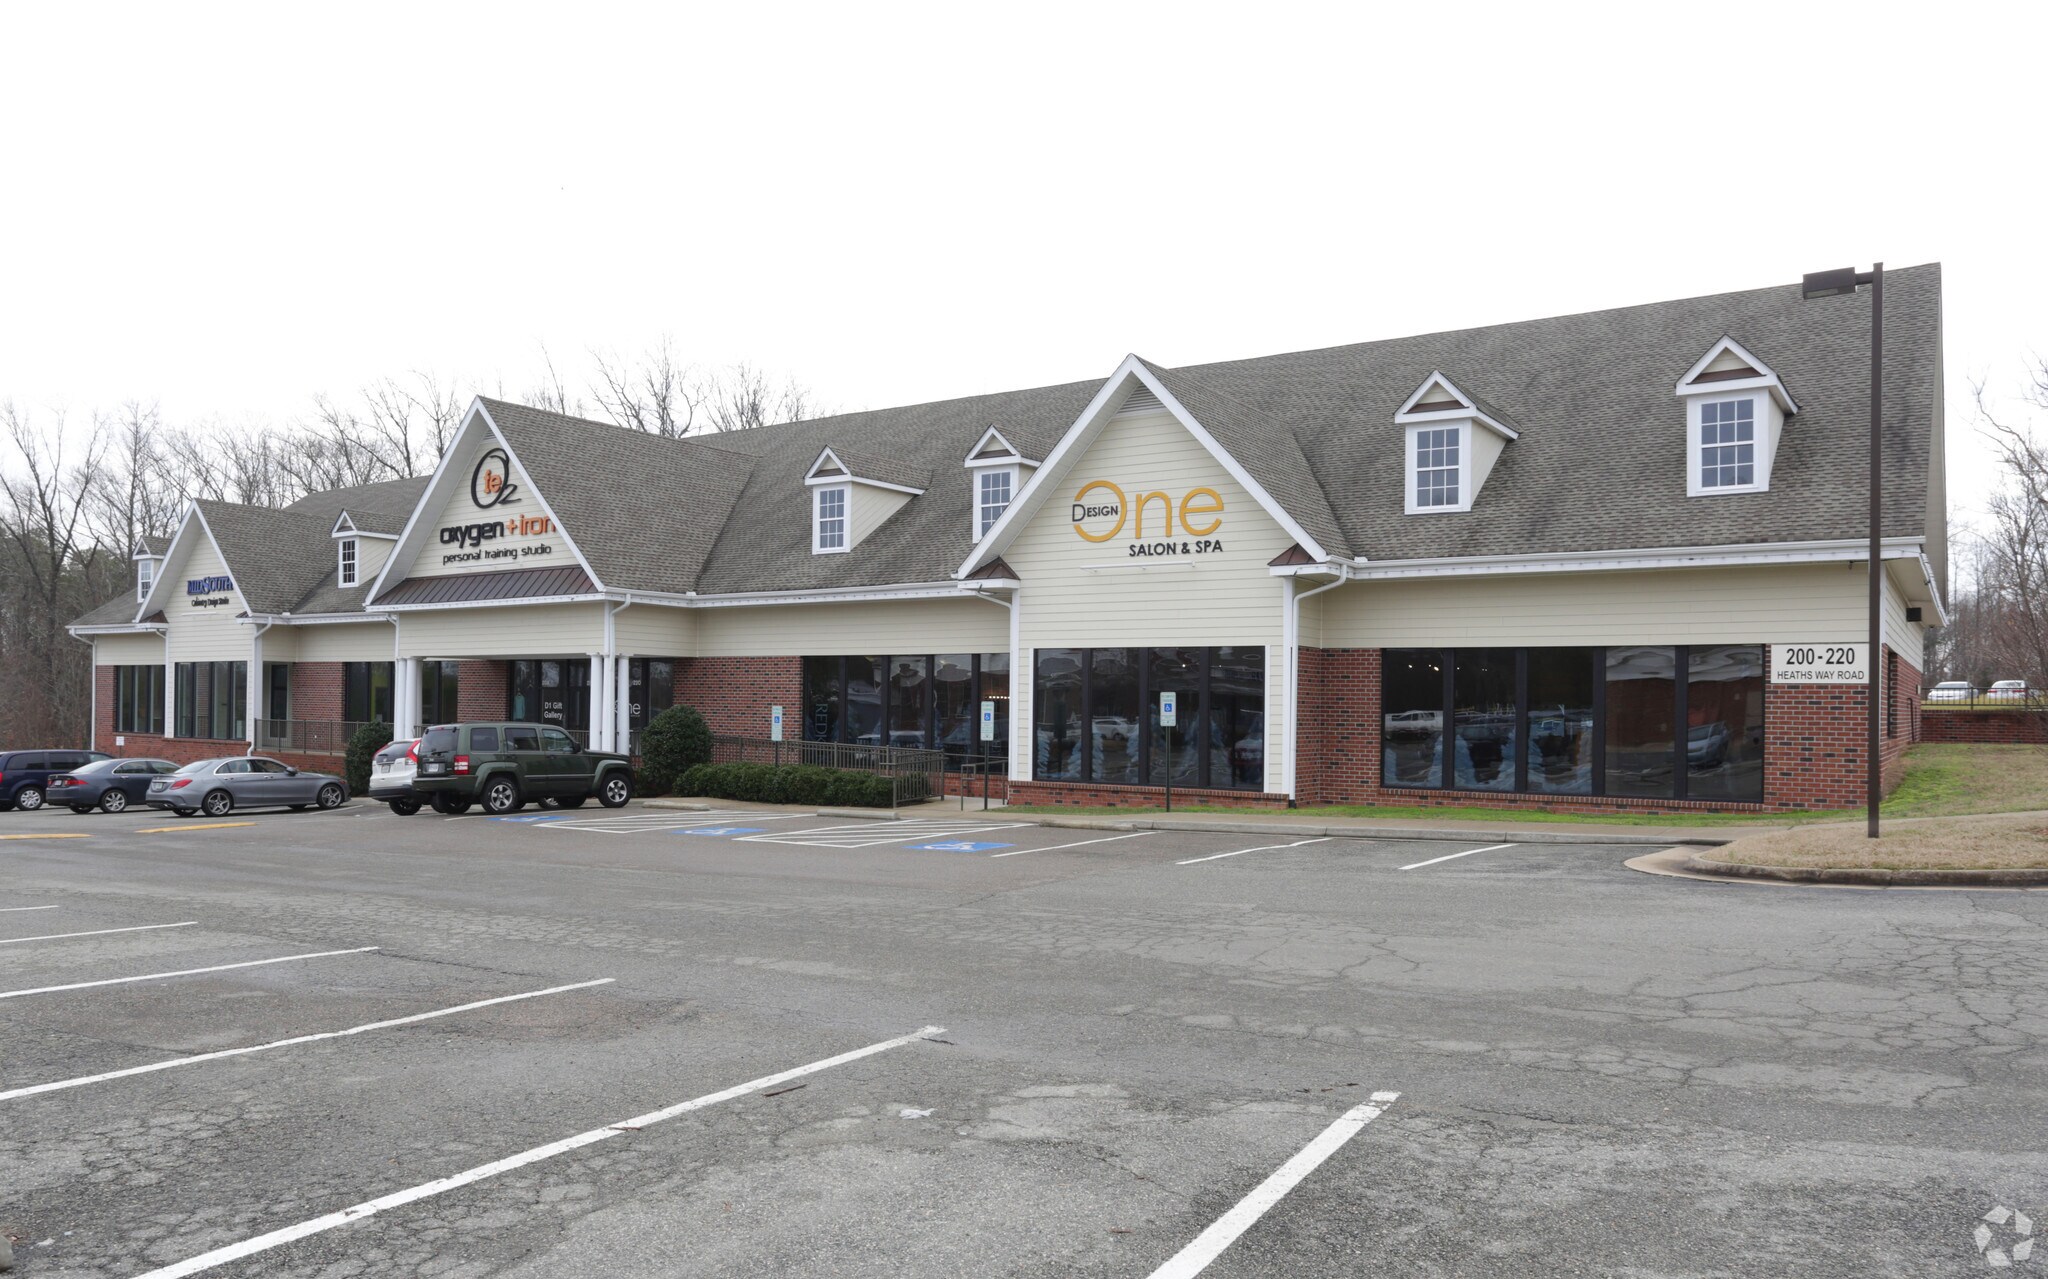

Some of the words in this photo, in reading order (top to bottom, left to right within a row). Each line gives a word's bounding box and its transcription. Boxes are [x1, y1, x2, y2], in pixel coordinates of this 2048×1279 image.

[1072, 504, 1118, 522] DESIGN
[1073, 480, 1224, 543] One
[440, 521, 504, 549] oxygen
[443, 549, 481, 565] personal
[485, 547, 517, 559] training
[521, 543, 551, 556] studio
[1129, 542, 1176, 557] SALON
[1181, 542, 1190, 554] &
[1195, 540, 1223, 553] SPA
[1777, 671, 1813, 680] HEATHS
[1815, 671, 1835, 680] WAY
[1837, 671, 1865, 680] ROAD
[553, 702, 563, 710] Gift
[544, 711, 563, 720] Gallery
